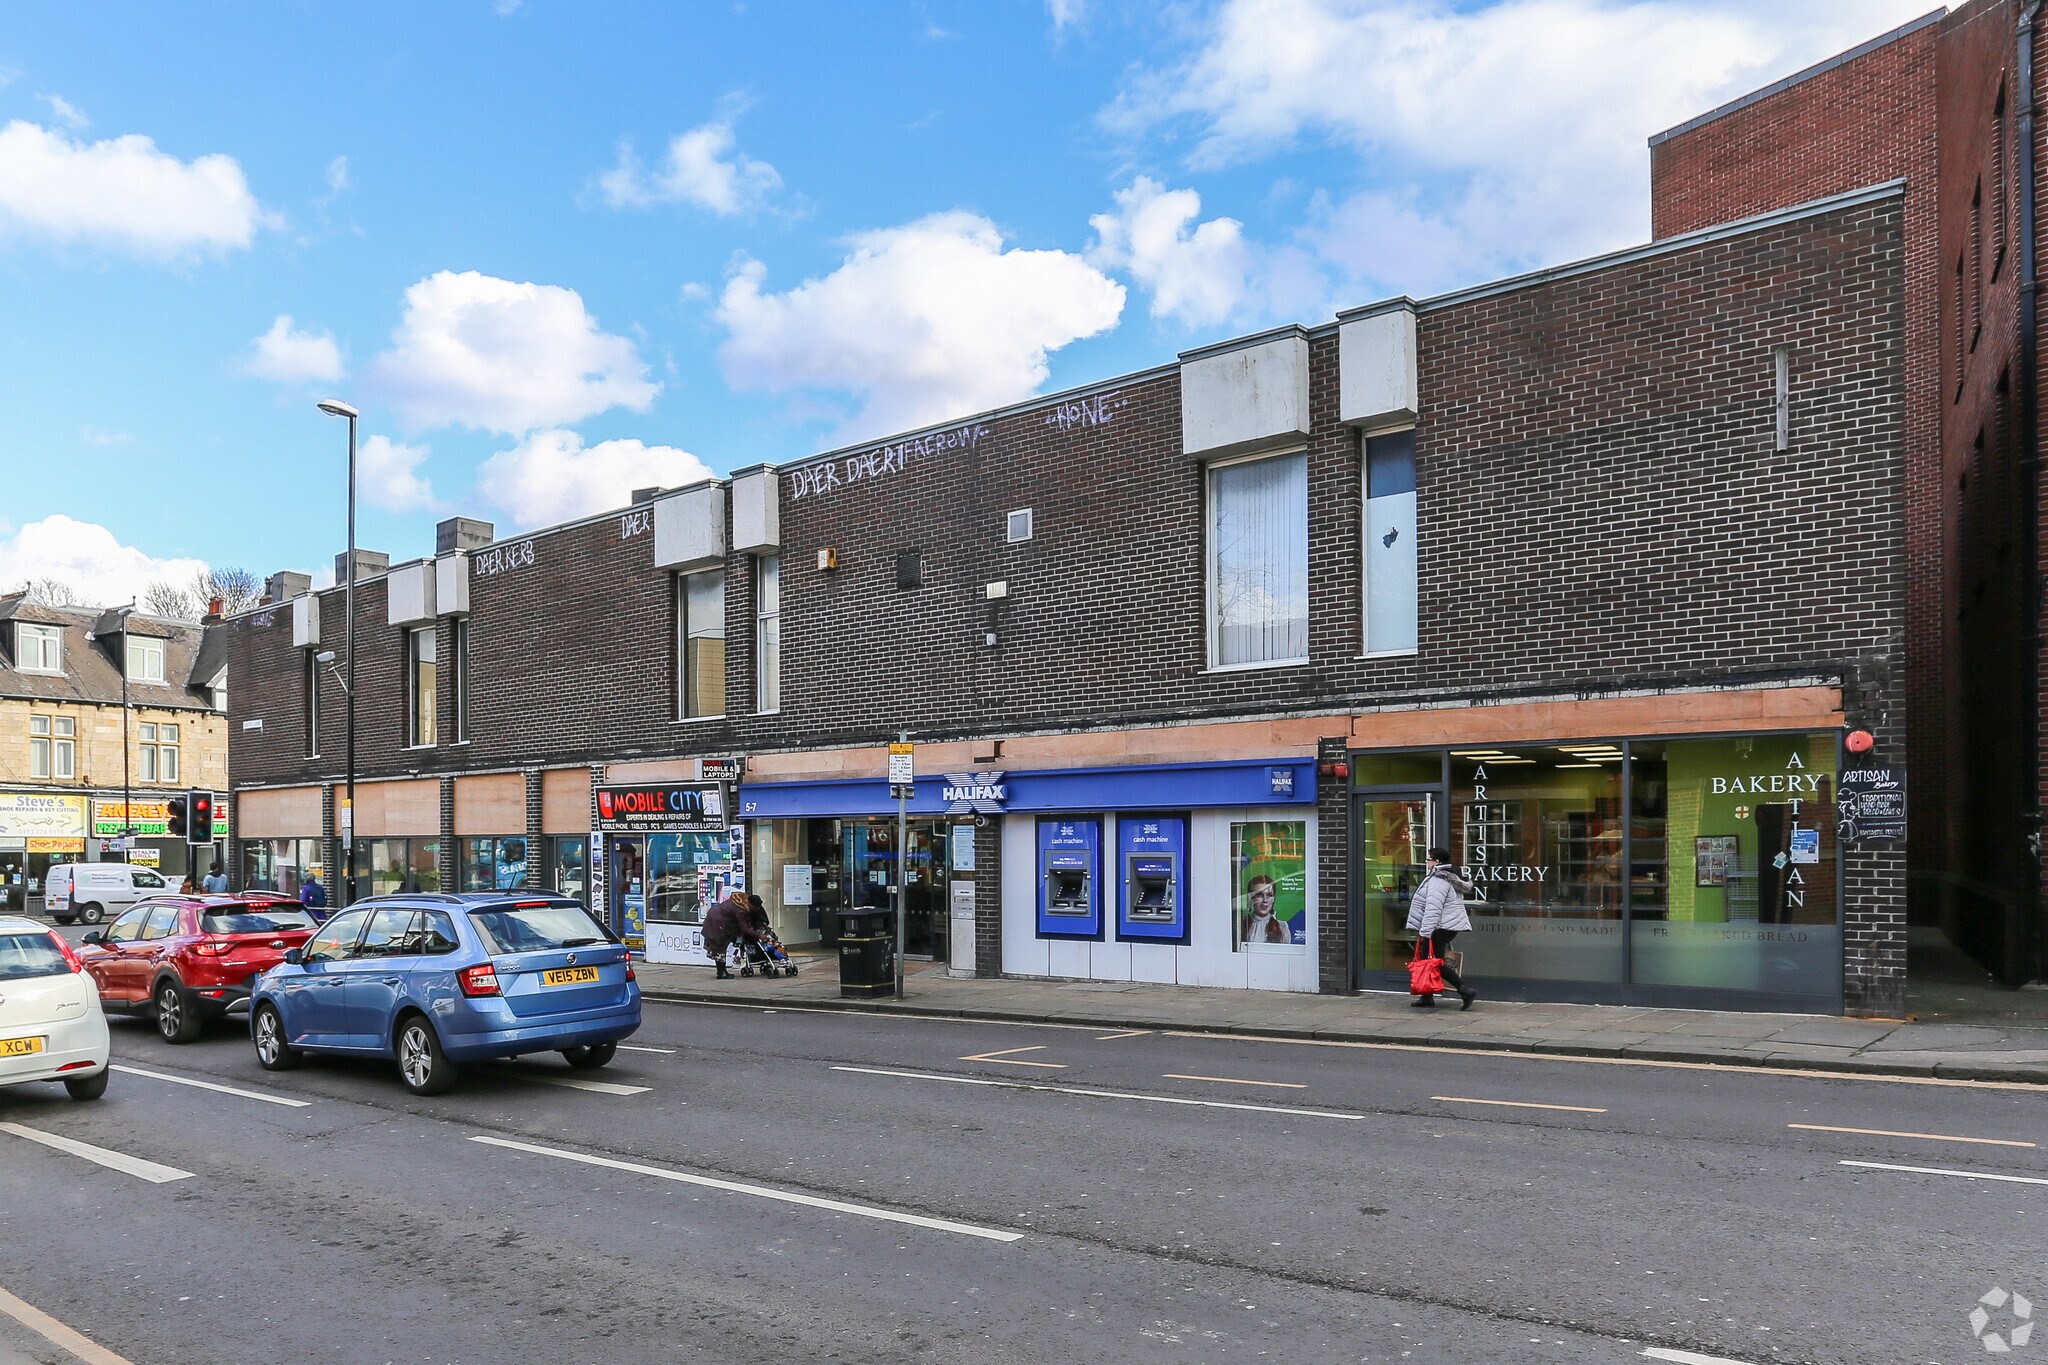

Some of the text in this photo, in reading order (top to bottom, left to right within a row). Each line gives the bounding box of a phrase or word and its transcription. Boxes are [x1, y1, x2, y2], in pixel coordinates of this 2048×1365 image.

[792, 463, 841, 500] DAER
[622, 511, 650, 540] DAER
[475, 549, 504, 576] DAER
[1711, 774, 1825, 794] BAKERY
[1842, 769, 1890, 783] ARTISAN
[17, 794, 65, 807] Steve's
[942, 785, 1005, 801] HALIFAX
[614, 791, 702, 812] MOBILE CITY
[745, 802, 757, 812] 5-7
[1473, 764, 1489, 901] ARTISAN
[30, 840, 82, 850] Shoe Repairs
[1460, 866, 1549, 882] BAKERY
[658, 932, 690, 951] Apple
[1757, 931, 1808, 943] BREAD
[547, 967, 595, 984] VE15 ZBN
[5, 1039, 33, 1053] XCW
